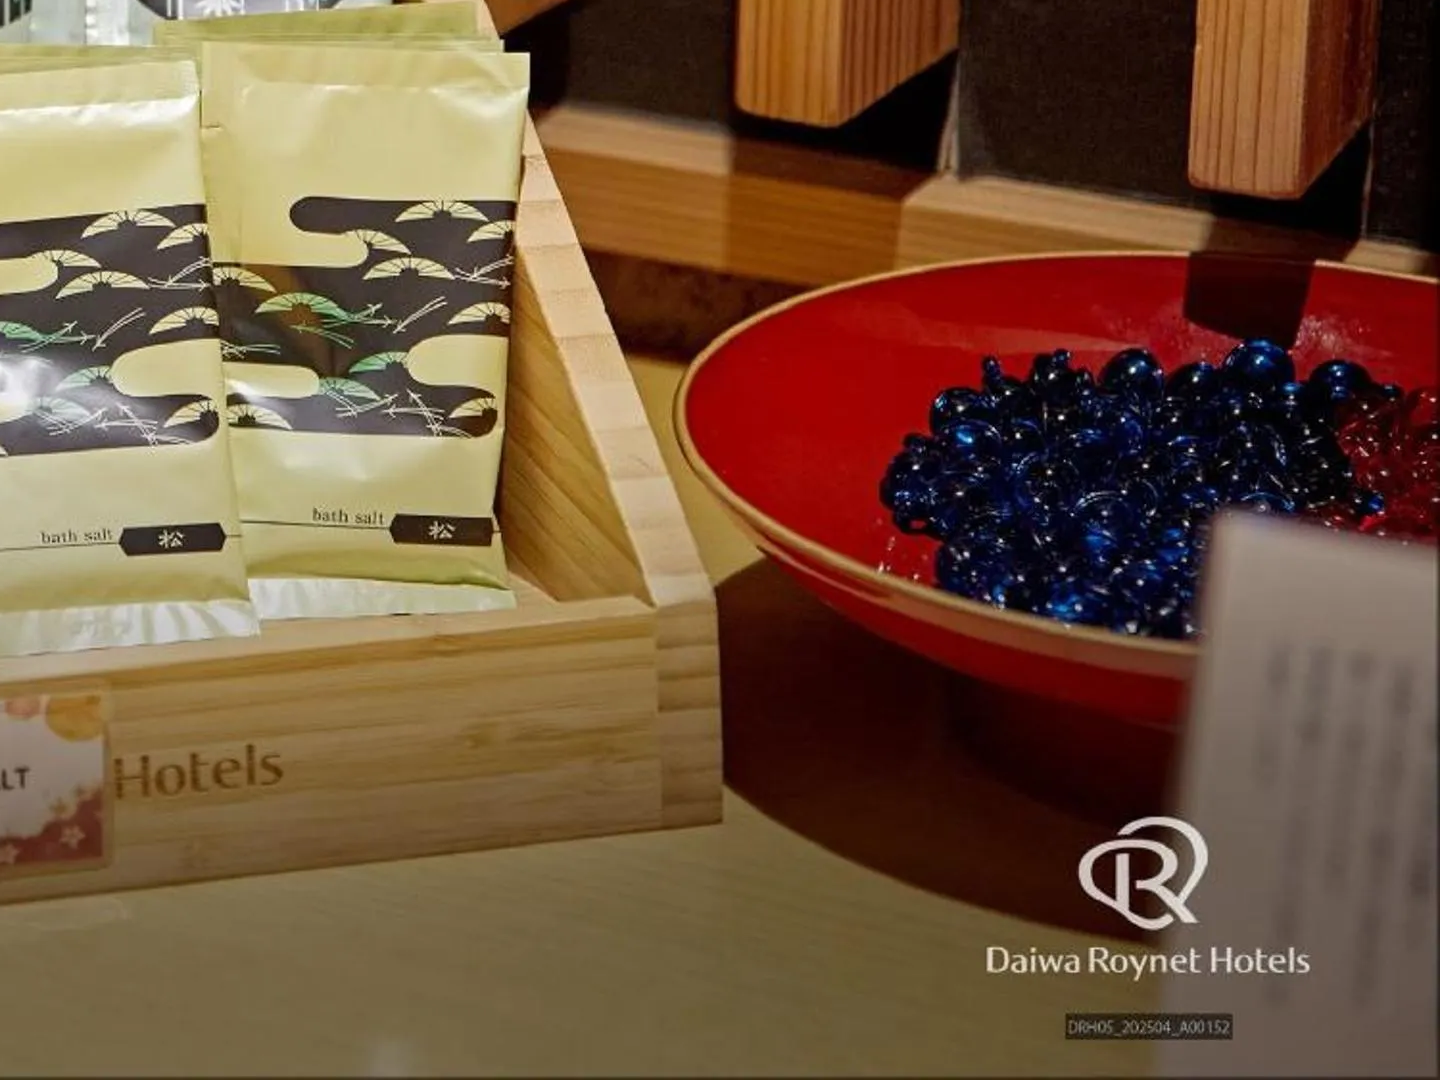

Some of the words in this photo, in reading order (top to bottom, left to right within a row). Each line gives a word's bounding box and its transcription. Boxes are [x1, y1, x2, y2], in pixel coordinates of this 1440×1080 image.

[311, 507, 348, 524] bath
[354, 509, 385, 525] salt
[41, 529, 79, 545] bath
[83, 527, 113, 543] salt
[158, 527, 186, 549] 松
[428, 520, 456, 540] 松
[113, 743, 285, 800] Hotels
